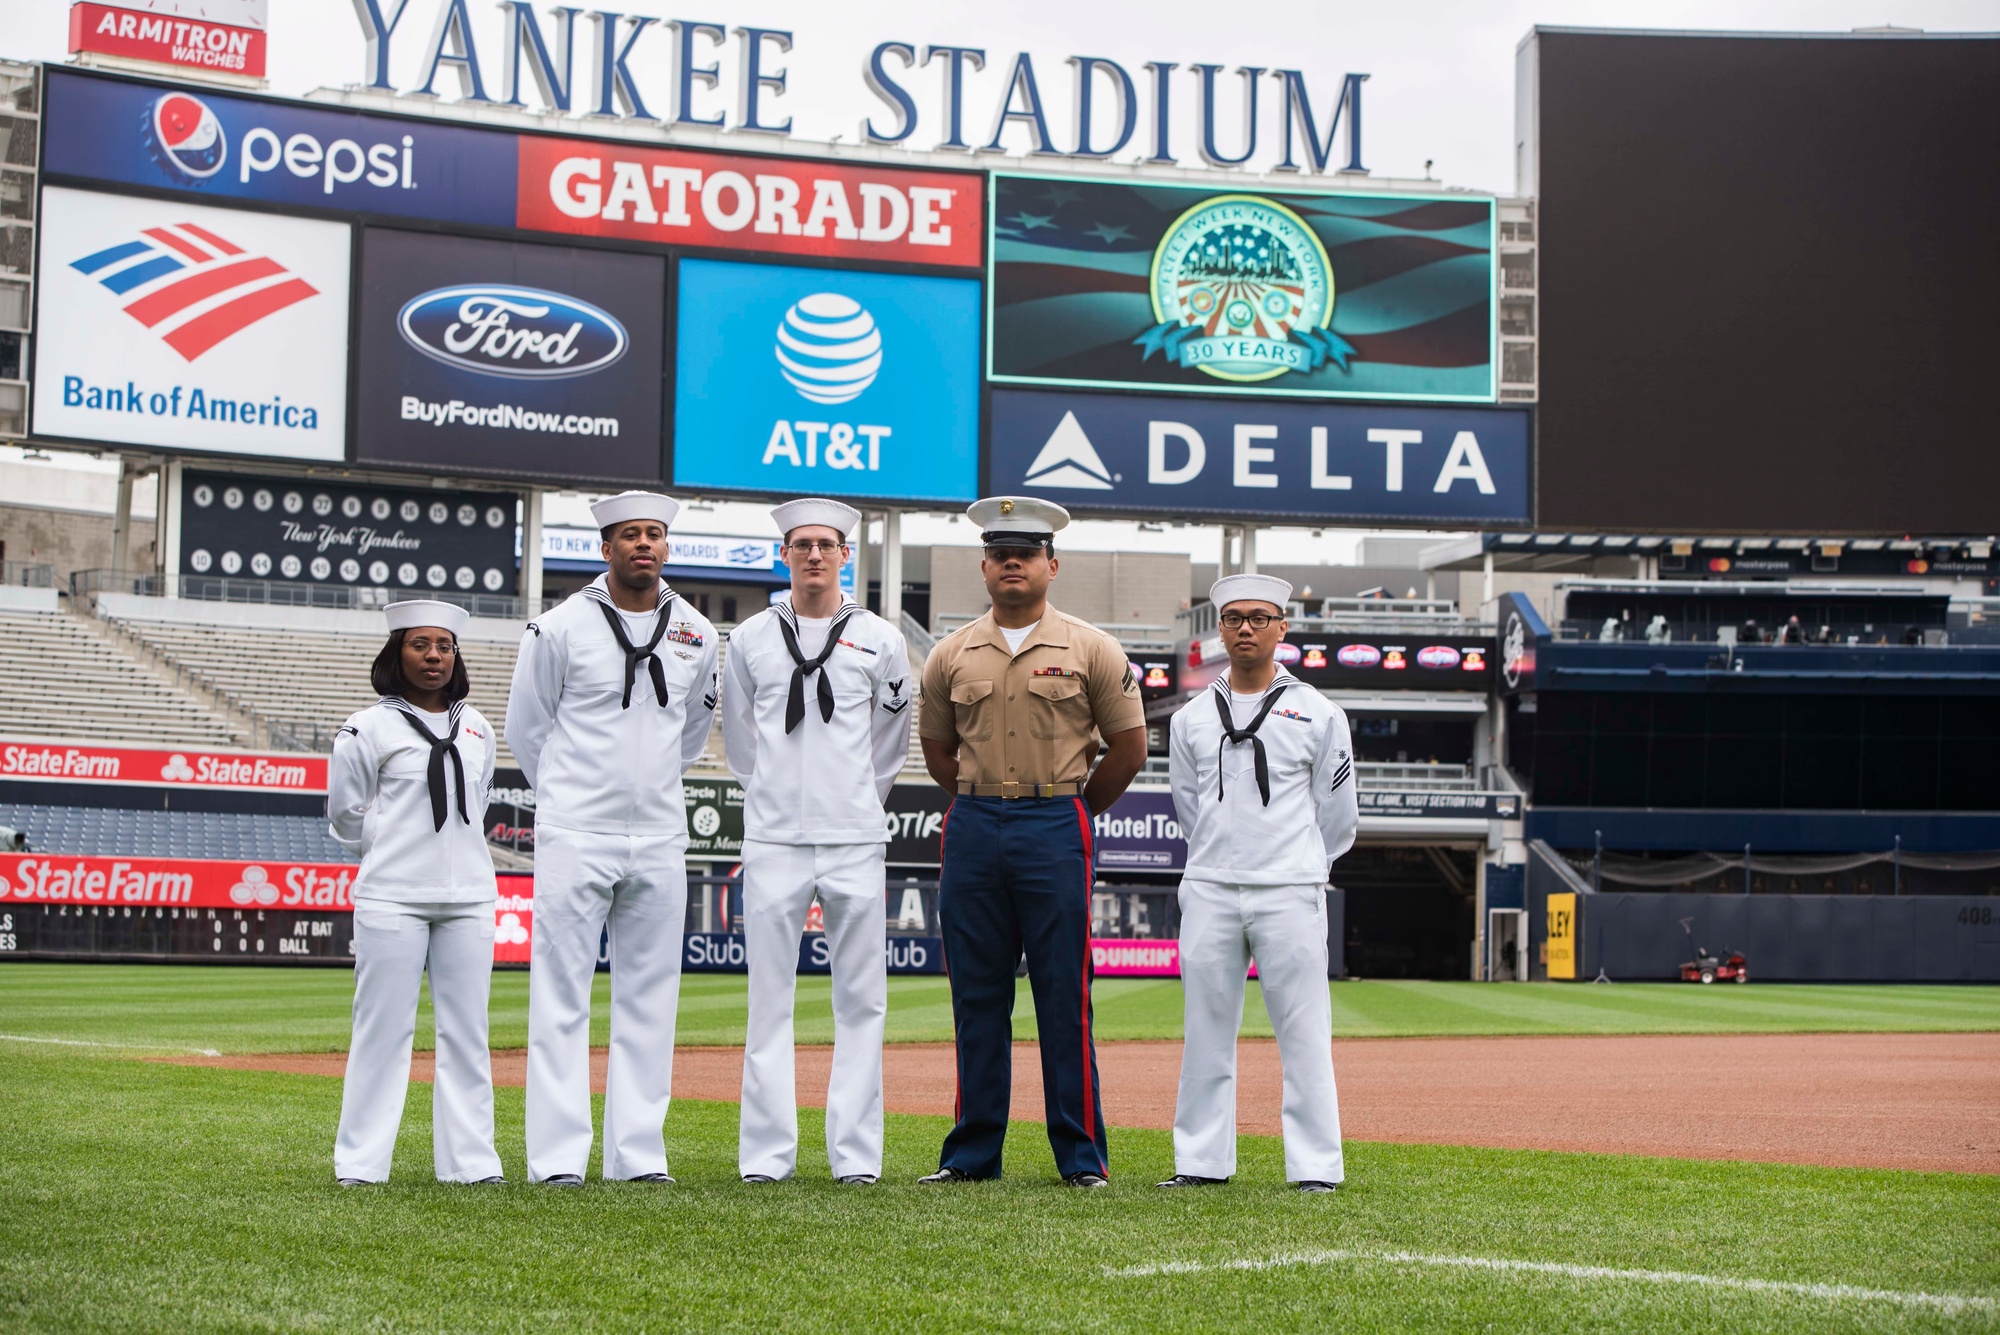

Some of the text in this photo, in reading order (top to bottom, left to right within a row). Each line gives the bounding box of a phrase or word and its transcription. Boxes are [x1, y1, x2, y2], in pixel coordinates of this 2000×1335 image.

[97, 12, 250, 55] ARMITRON
[172, 45, 246, 70] WATCHES
[350, 0, 1371, 175] YANKEE STADIUM
[240, 127, 414, 194] pepsi
[549, 157, 952, 246] GATORADE
[1161, 206, 1321, 289] FLEET WEEK NEW YORK
[444, 296, 583, 364] Ford
[1190, 341, 1299, 363] 30 YEARS
[63, 375, 318, 430] Bank of America
[401, 396, 619, 437] BuyFordNow.com
[762, 420, 892, 471] AT&T
[1148, 420, 1496, 495] DELTA
[280, 521, 421, 555] New York Yankees
[550, 537, 562, 551] TO
[567, 539, 591, 552] NEW
[1735, 560, 1789, 571] masterpass
[1933, 561, 1987, 572] masterpass
[3, 746, 120, 777] StateFarm
[196, 757, 306, 786] StateFarm
[1358, 793, 1375, 806] THE
[1405, 794, 1428, 807] VISIT
[1428, 795, 1466, 808] SECTION
[13, 859, 194, 903] StateFarm
[43, 905, 48, 915] 1
[60, 905, 67, 916] 2
[76, 905, 83, 916] 3
[91, 906, 99, 916] 4
[108, 906, 115, 917] 5
[124, 906, 131, 917] 6
[141, 907, 147, 918] 7
[156, 907, 163, 918] 8
[172, 907, 179, 919] 9
[185, 908, 198, 919] 10
[1958, 907, 1992, 925] 408
[214, 920, 333, 937] 0 0 AT BAT
[213, 938, 310, 954] 0 0 0 BALL
[687, 935, 748, 965] Stub
